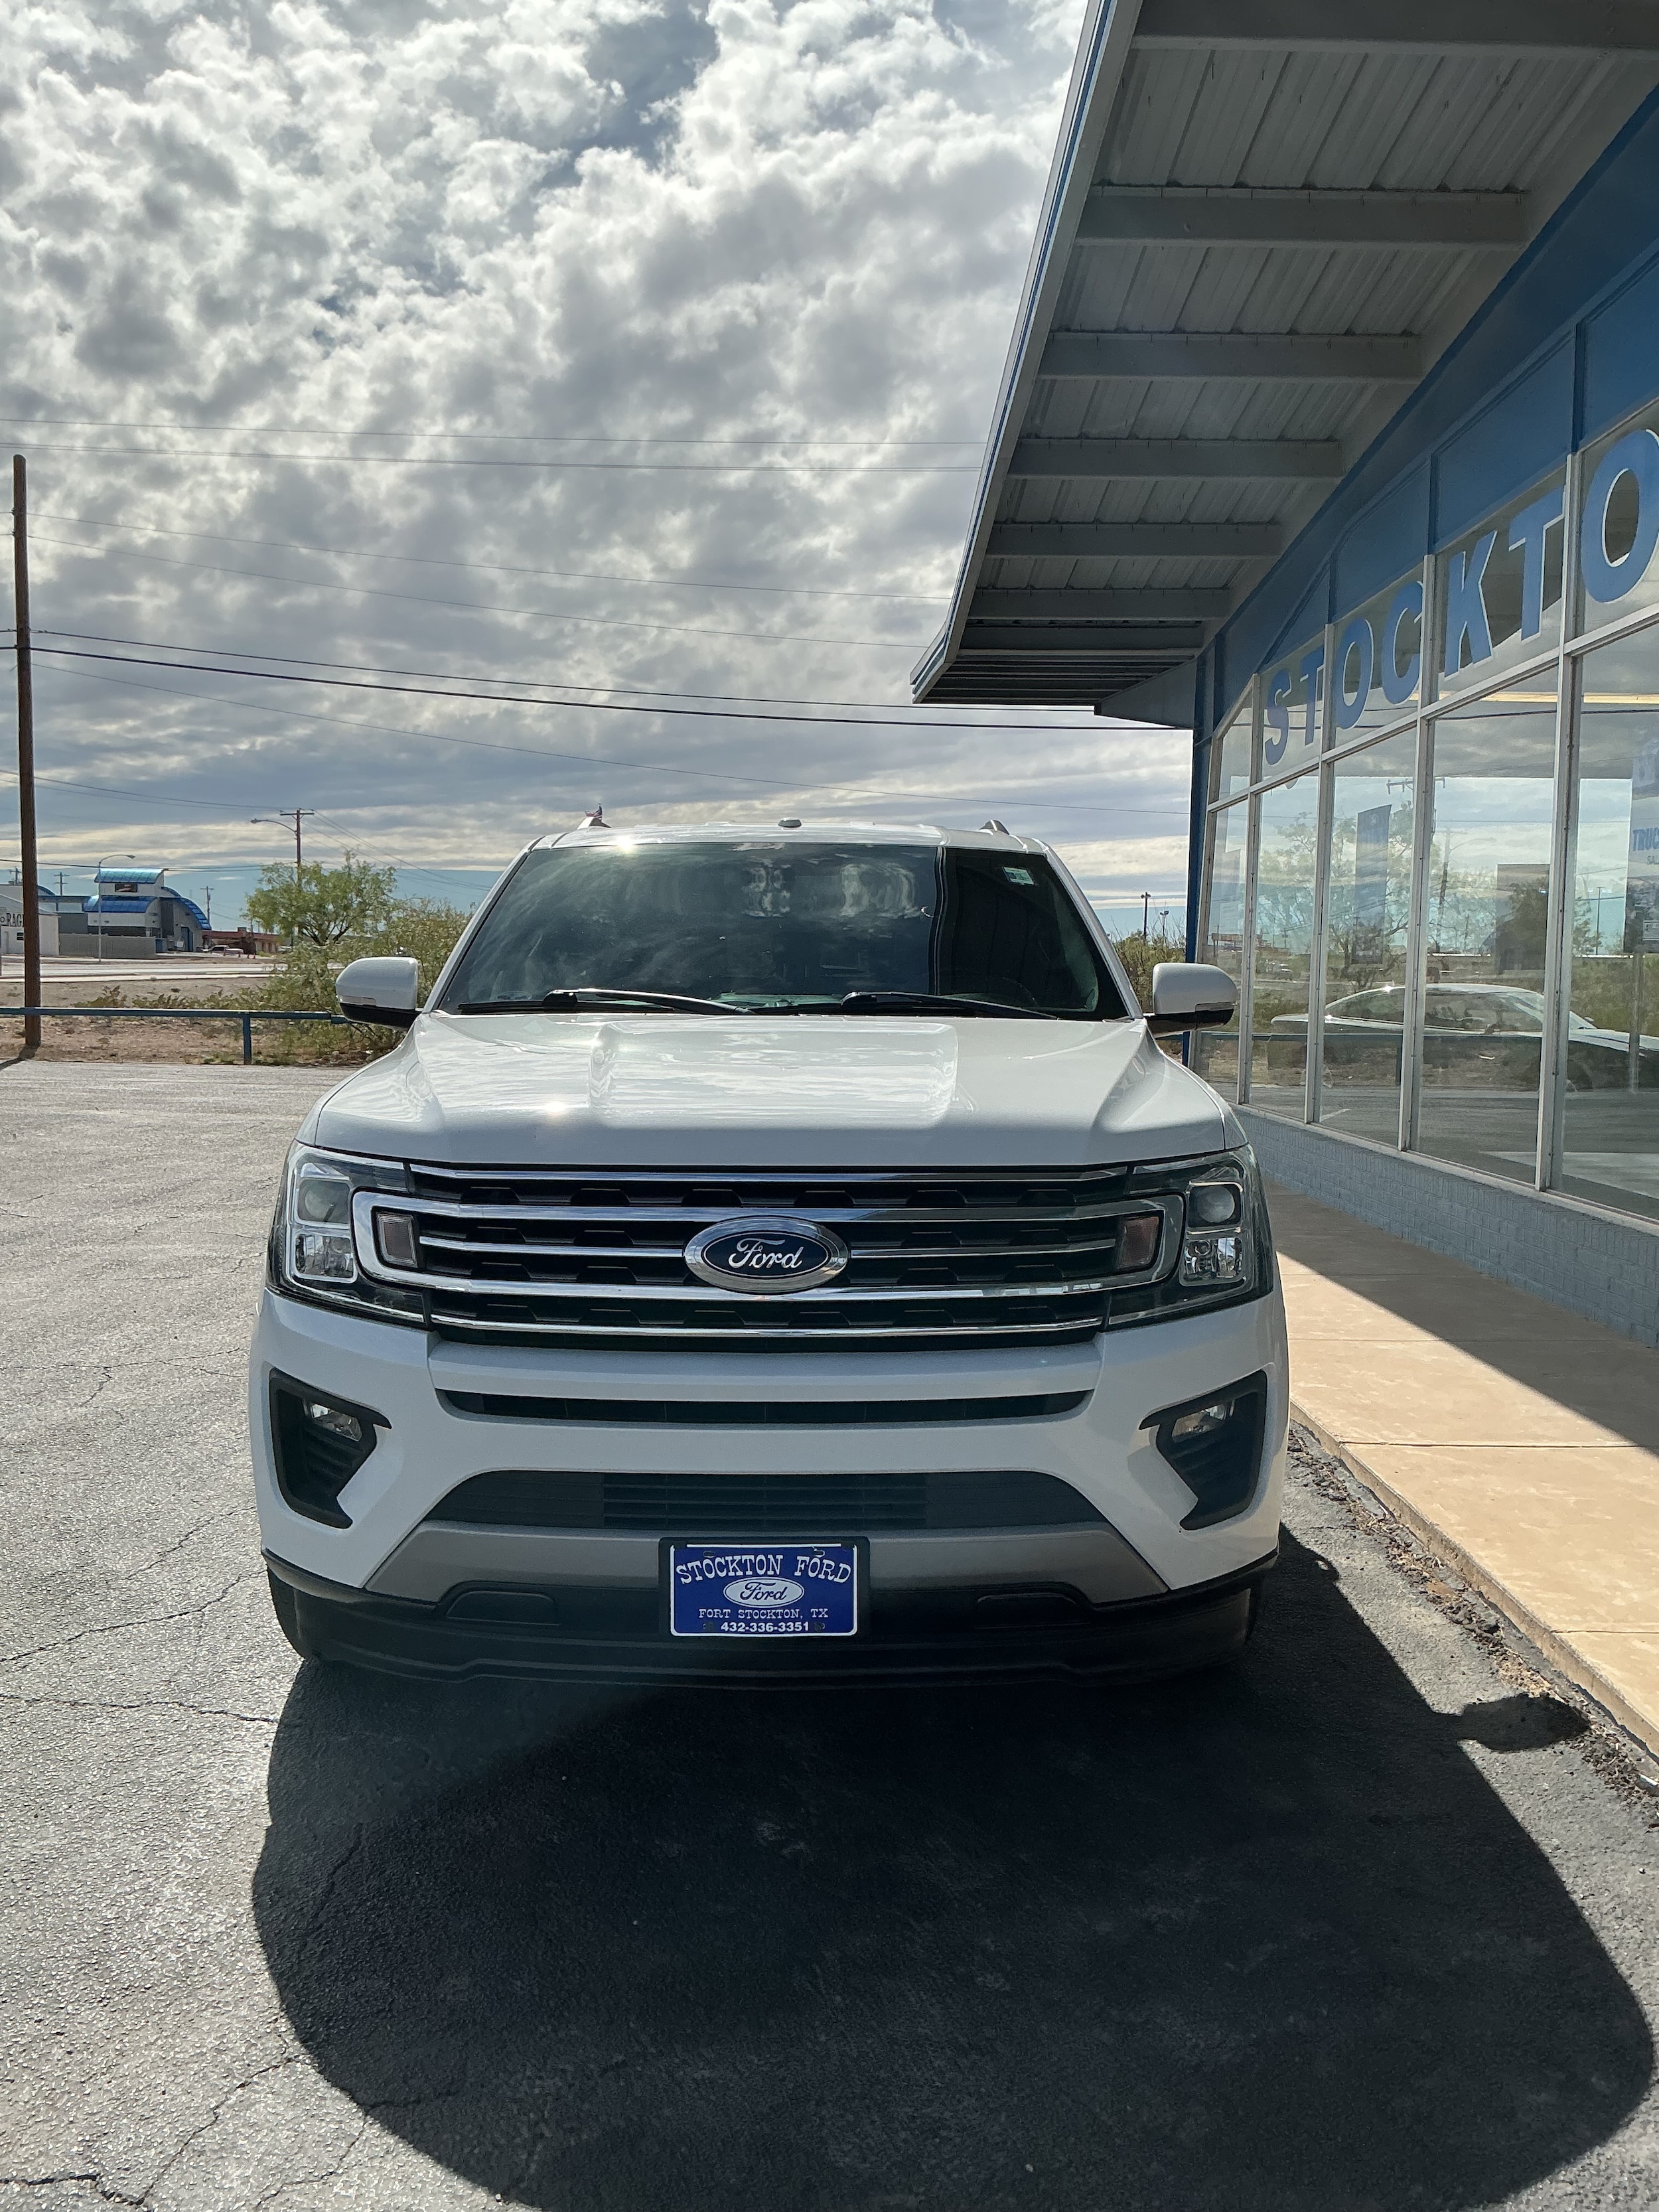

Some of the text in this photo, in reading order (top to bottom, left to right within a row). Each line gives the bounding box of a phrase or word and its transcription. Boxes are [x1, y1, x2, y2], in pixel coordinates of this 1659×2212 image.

[1264, 429, 1659, 766] STOCKTO
[729, 1238, 804, 1268] Ford
[676, 1554, 851, 1584] STOCKTON FORD
[740, 1582, 787, 1601] Ford
[699, 1608, 829, 1619] FORT STOCKTON, TX
[721, 1622, 810, 1632] 432-336-3351
